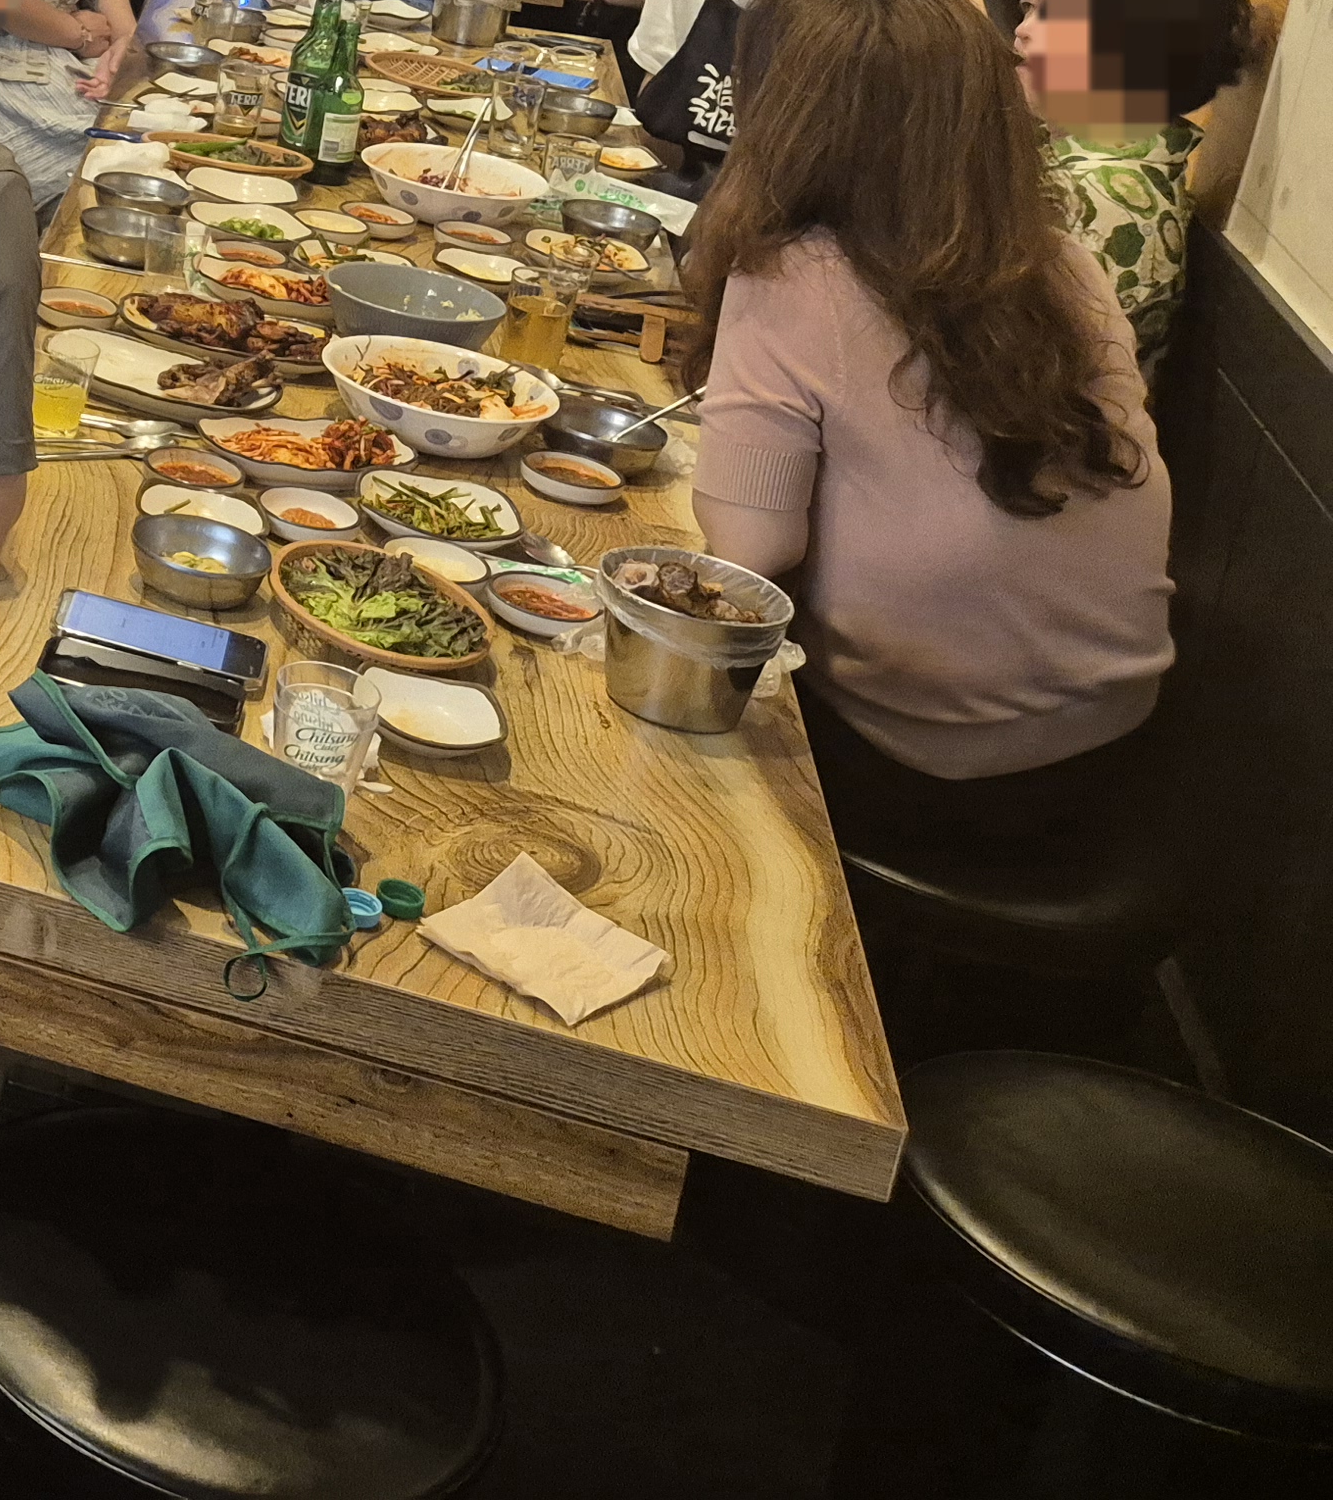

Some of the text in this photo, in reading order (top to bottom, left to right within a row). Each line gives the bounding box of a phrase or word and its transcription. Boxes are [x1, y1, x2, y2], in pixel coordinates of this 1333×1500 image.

[697, 63, 733, 107] 처음
[687, 97, 737, 137] 처럼
[284, 743, 346, 770] Chilsung
